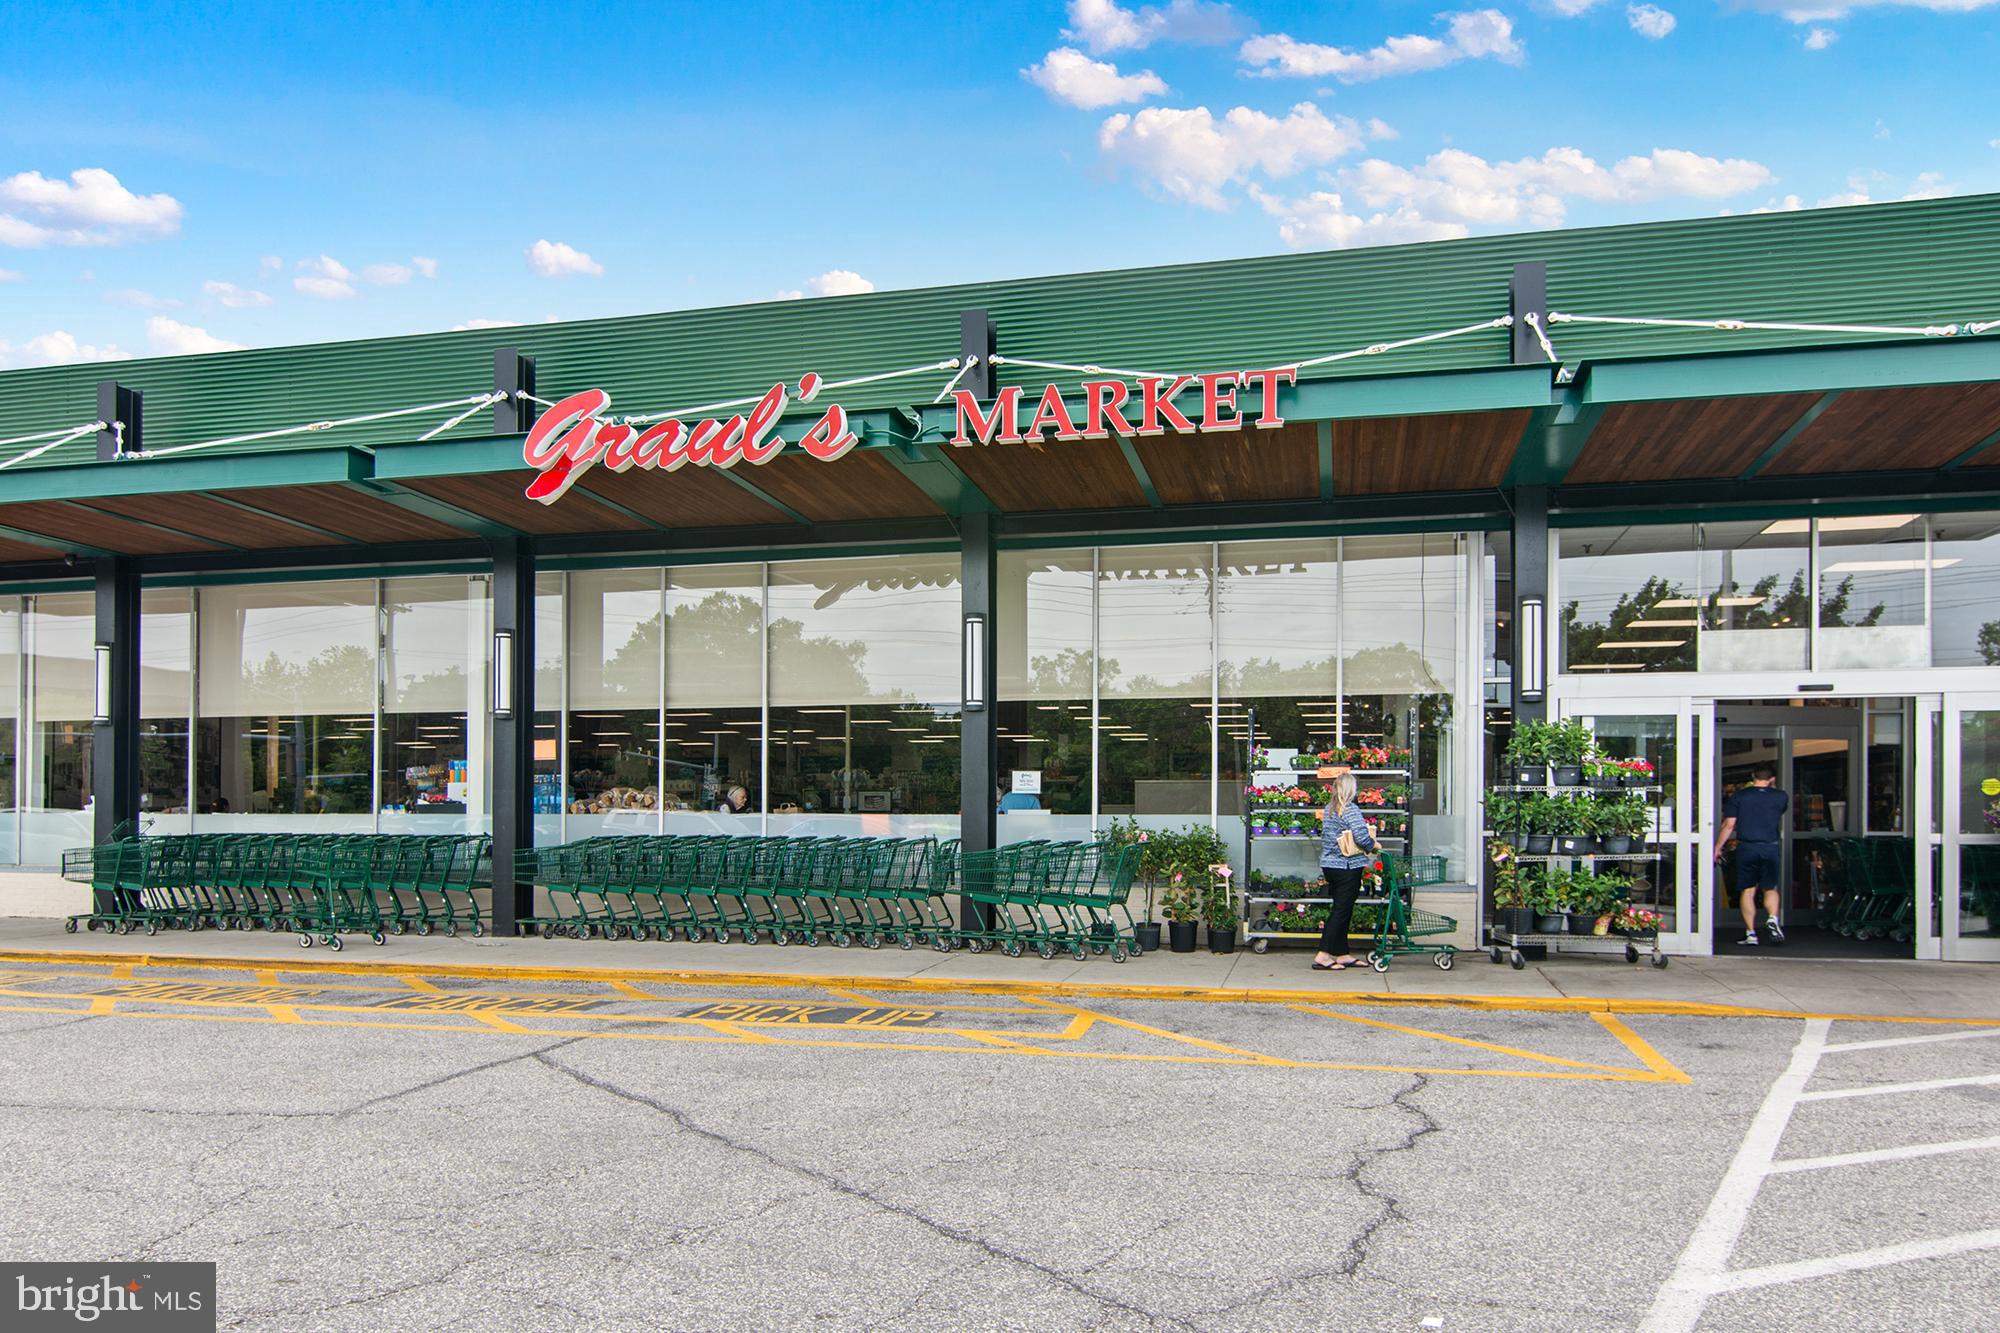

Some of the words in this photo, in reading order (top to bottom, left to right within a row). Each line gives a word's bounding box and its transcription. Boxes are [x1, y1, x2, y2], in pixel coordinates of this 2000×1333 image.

[524, 372, 858, 505] Graul's
[950, 367, 1298, 447] MARKET
[375, 996, 601, 1013] PARCEL
[686, 1004, 837, 1023] PICK
[844, 1009, 937, 1027] UP
